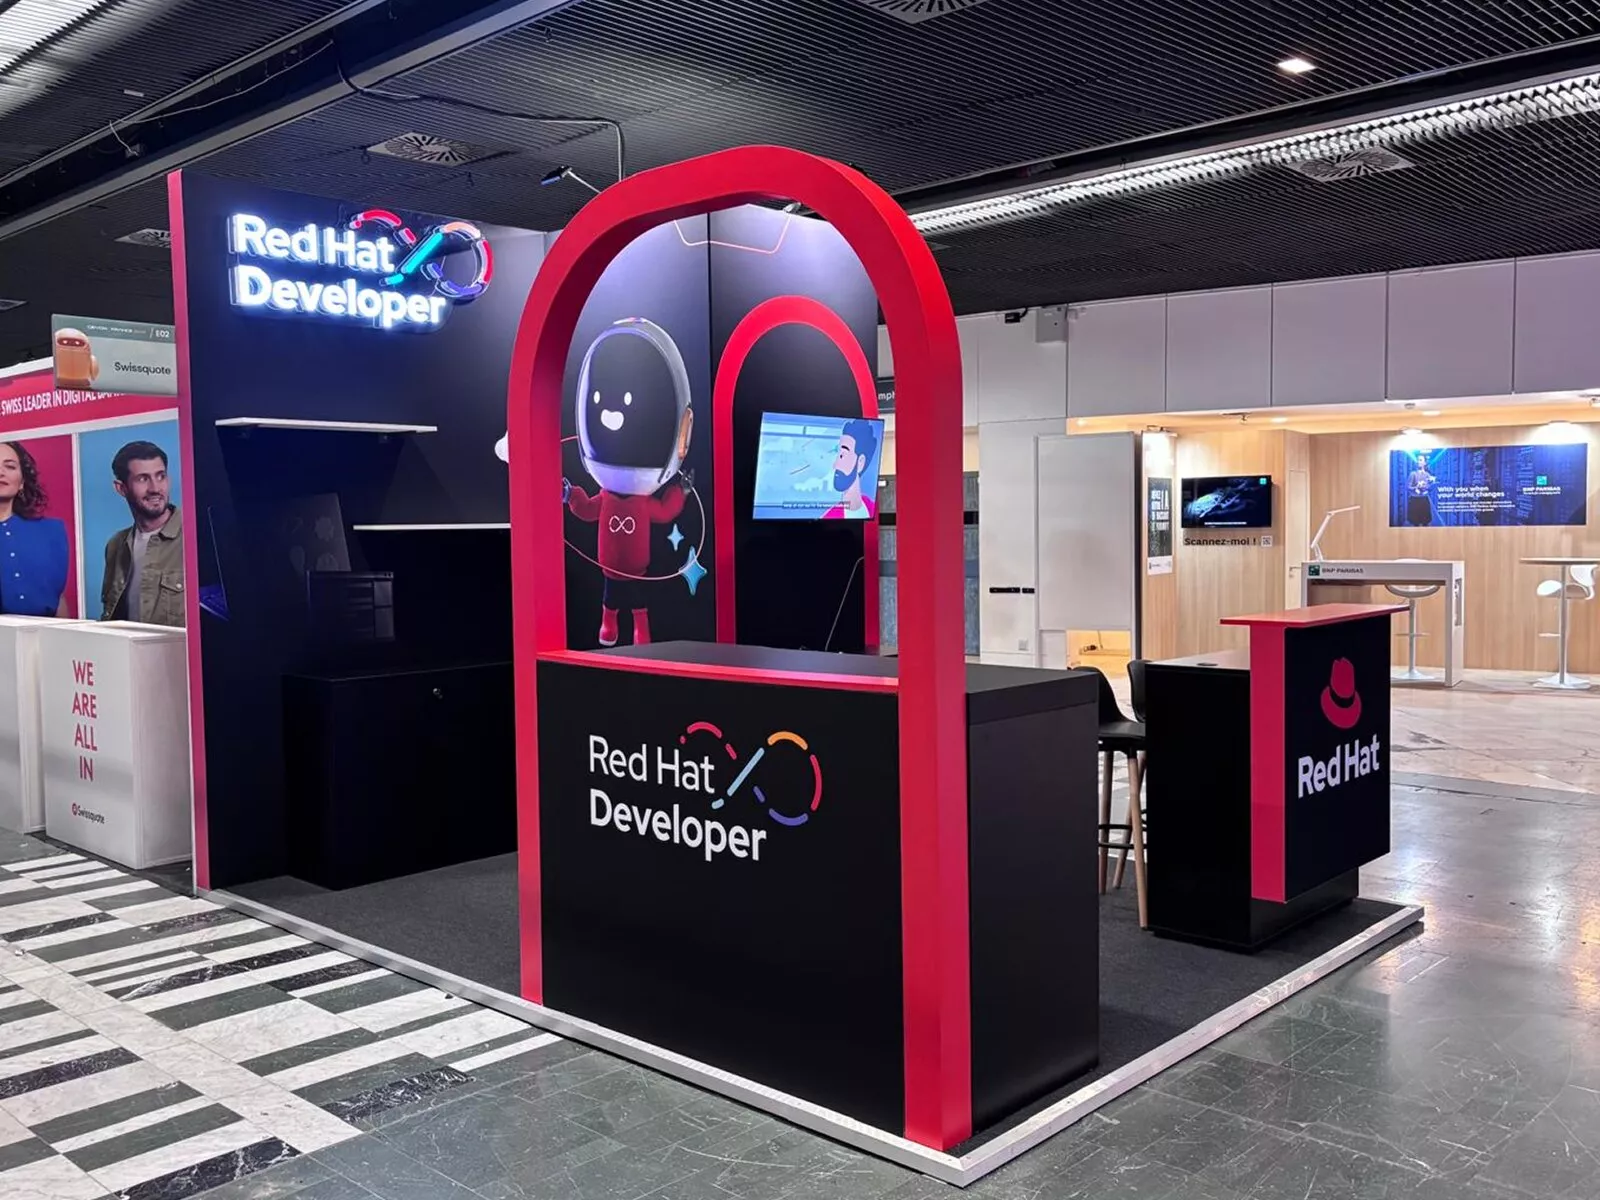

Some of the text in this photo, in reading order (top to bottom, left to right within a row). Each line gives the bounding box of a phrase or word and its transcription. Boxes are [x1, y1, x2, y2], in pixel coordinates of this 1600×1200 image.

[232, 212, 395, 273] Red Hat
[233, 264, 447, 328] Developer
[114, 361, 171, 376] Swissquote
[1, 396, 23, 416] SWISS
[22, 391, 52, 412] LEADER
[52, 389, 62, 408] IN
[1184, 537, 1250, 546] Scannez-moi
[72, 659, 94, 686] WE
[72, 692, 98, 719] ARE
[74, 722, 98, 751] ALL
[79, 755, 94, 782] IN
[589, 734, 716, 794] Red Hat
[1298, 733, 1380, 799] Red Hat
[77, 804, 105, 825] Swissquote
[590, 788, 767, 862] Developer
